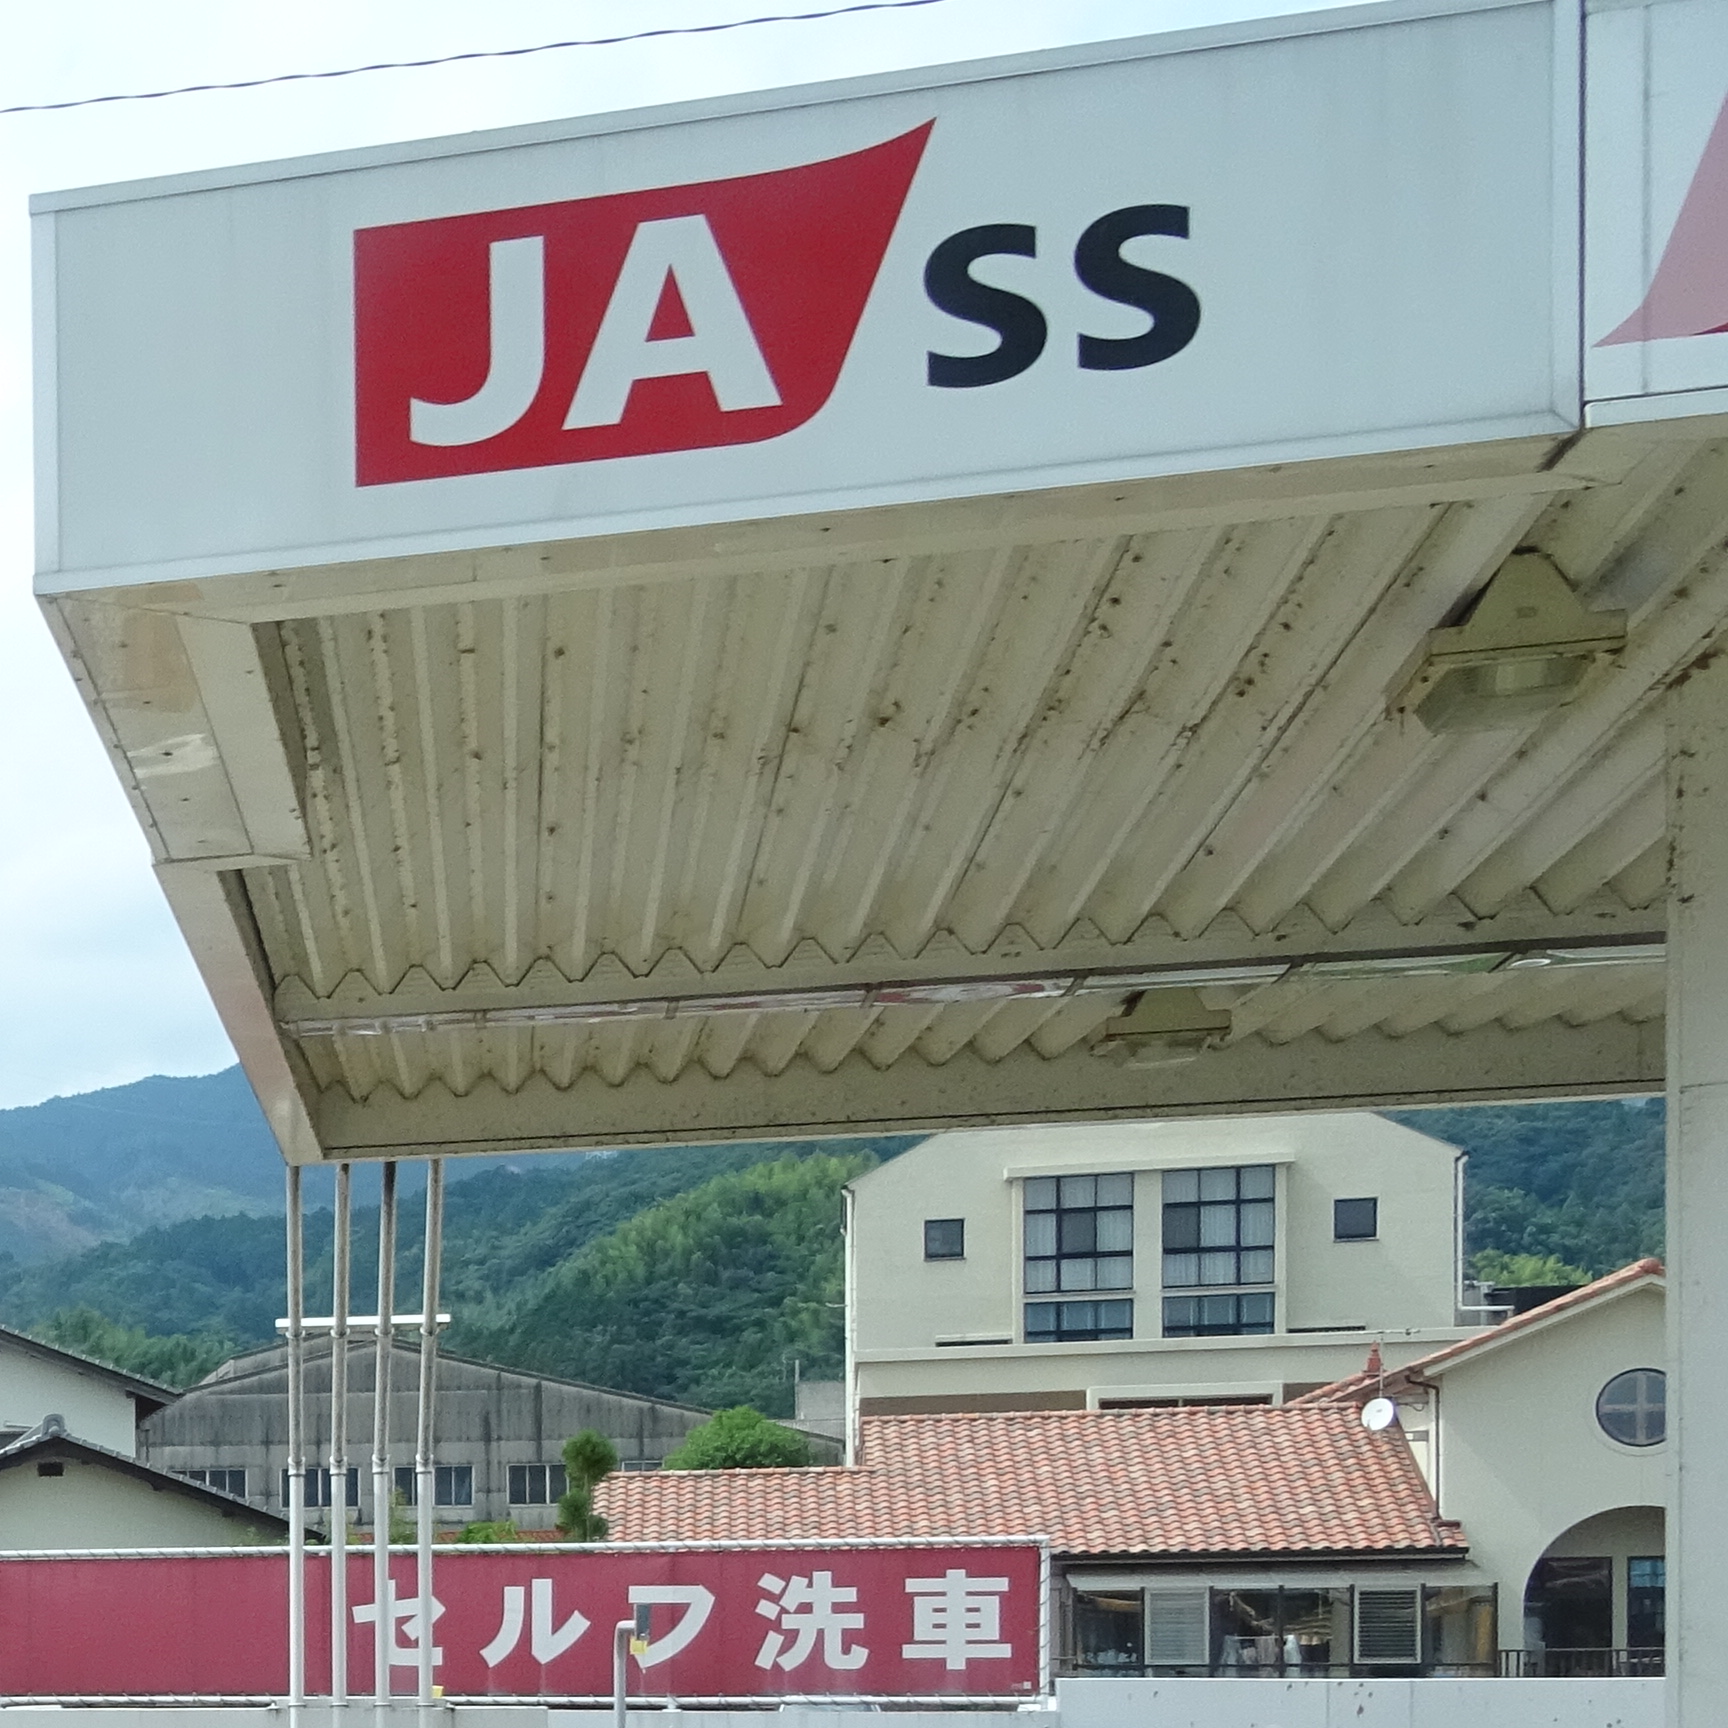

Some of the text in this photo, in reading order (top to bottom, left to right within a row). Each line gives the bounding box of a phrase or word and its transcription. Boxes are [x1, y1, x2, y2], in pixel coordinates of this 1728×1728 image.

[408, 203, 1203, 448] JA SS
[352, 1568, 1013, 1671] セルフ洗車
